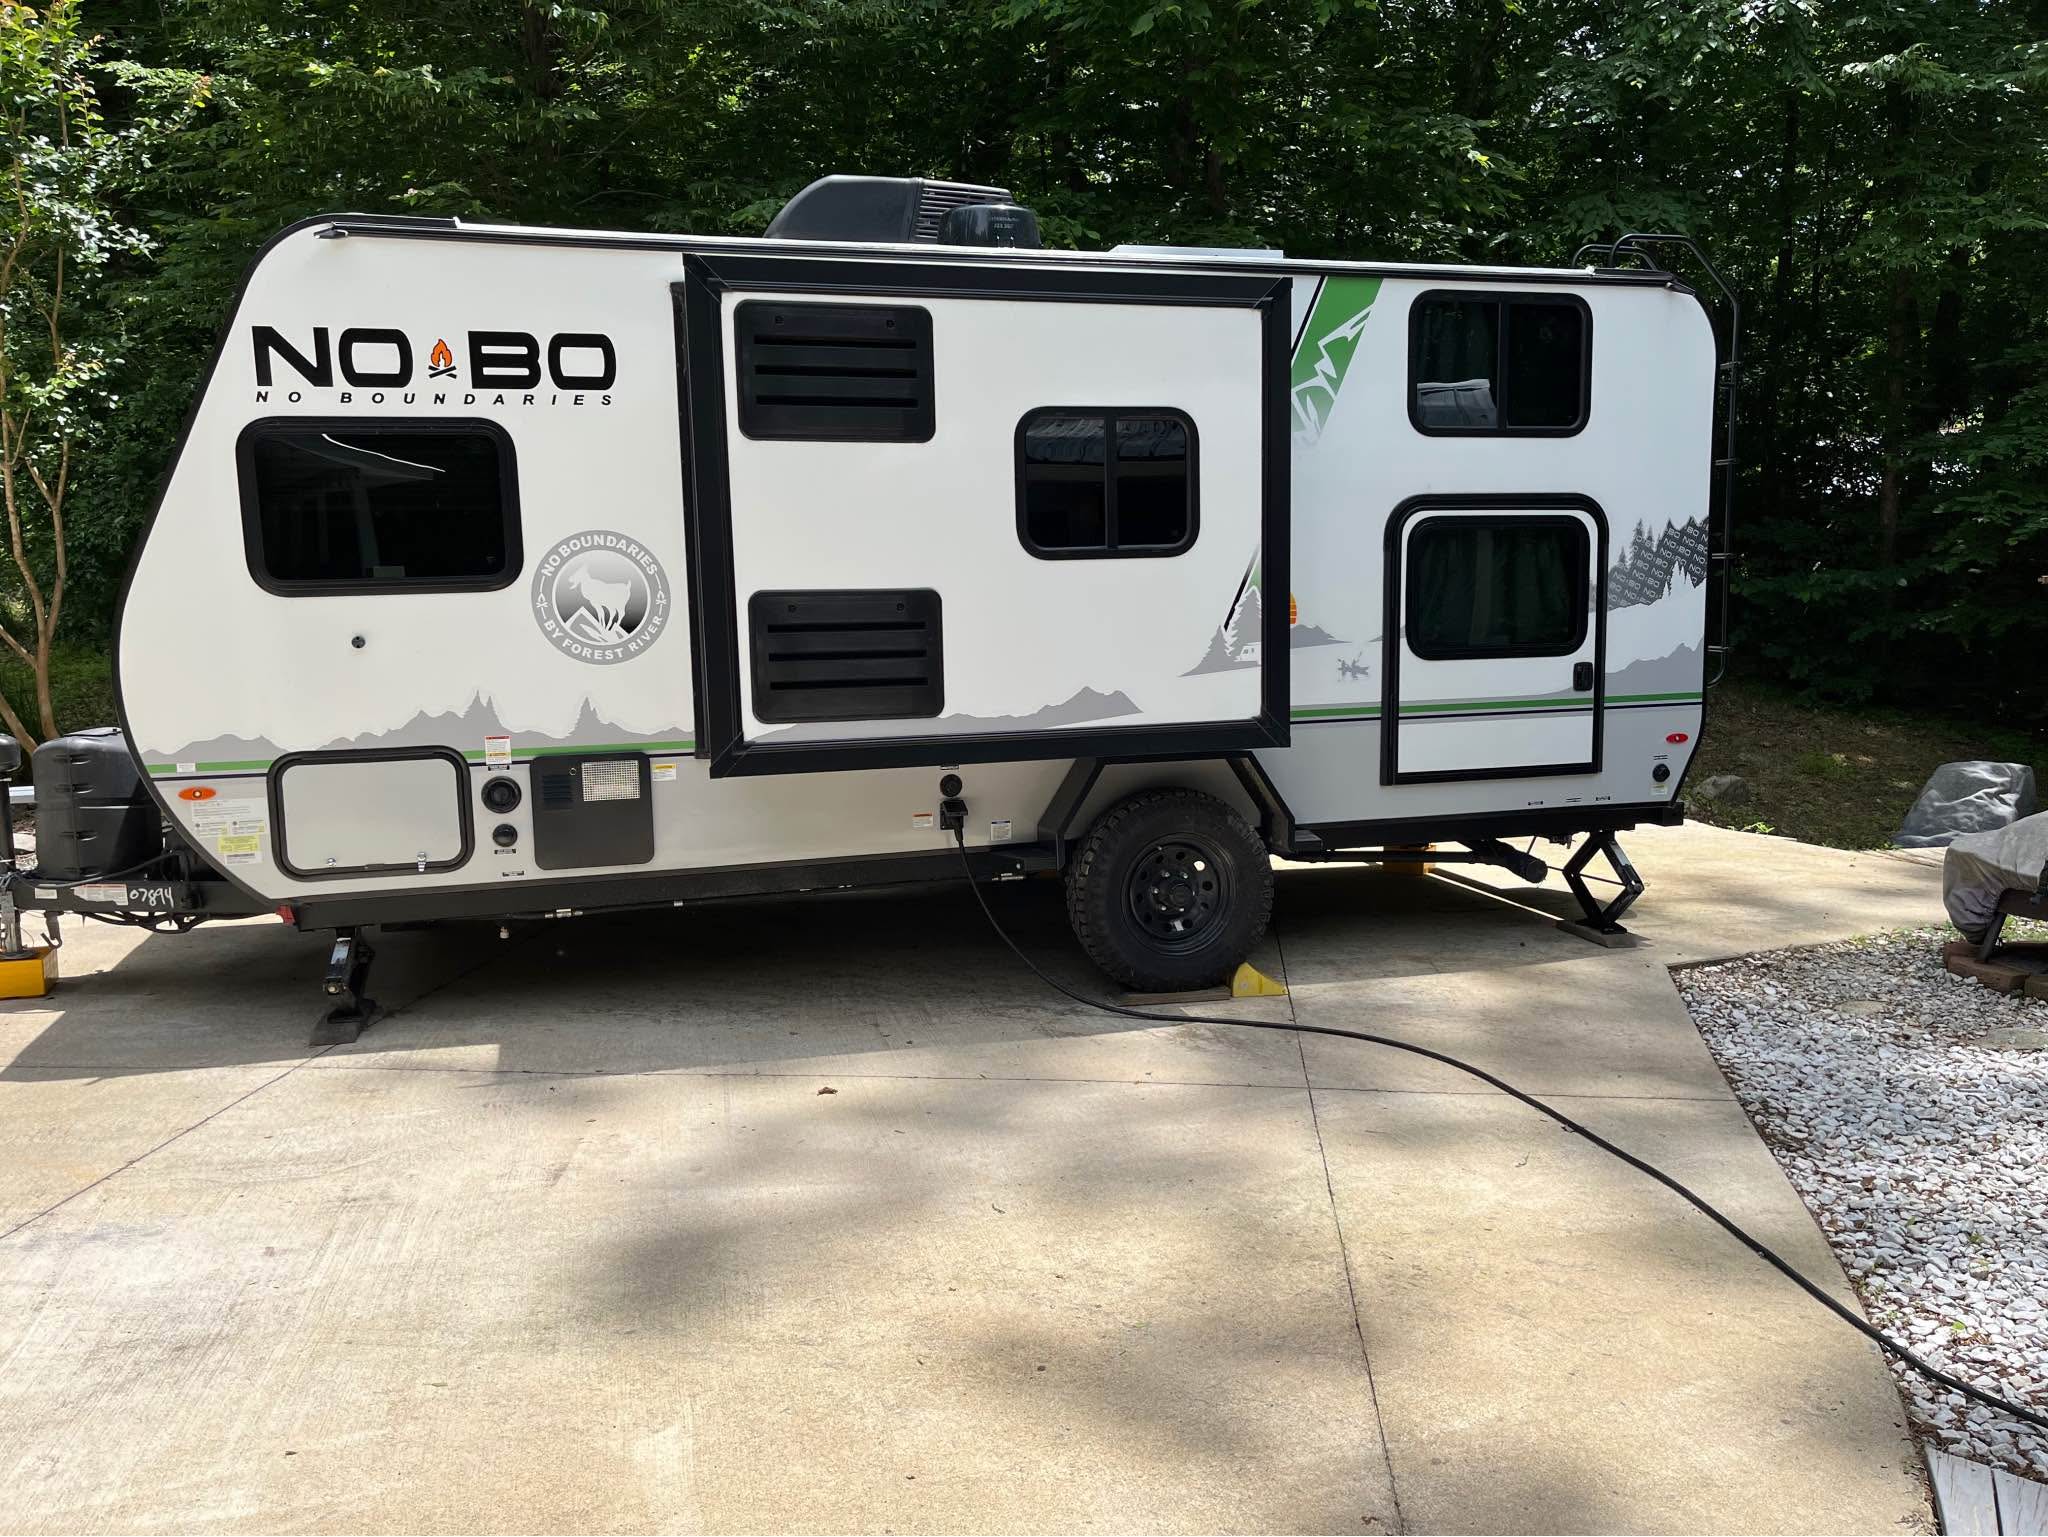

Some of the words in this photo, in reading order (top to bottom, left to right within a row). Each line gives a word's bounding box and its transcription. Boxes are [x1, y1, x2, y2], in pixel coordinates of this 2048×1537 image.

[252, 325, 413, 388] NO
[468, 330, 617, 391] BO
[255, 391, 302, 404] NO
[340, 392, 612, 406] BOUNDARIES
[541, 554, 561, 577] NO
[558, 534, 658, 575] BOUNDARIES
[544, 619, 564, 639] BY
[562, 638, 624, 660] FOREST
[627, 615, 663, 652] RIVER
